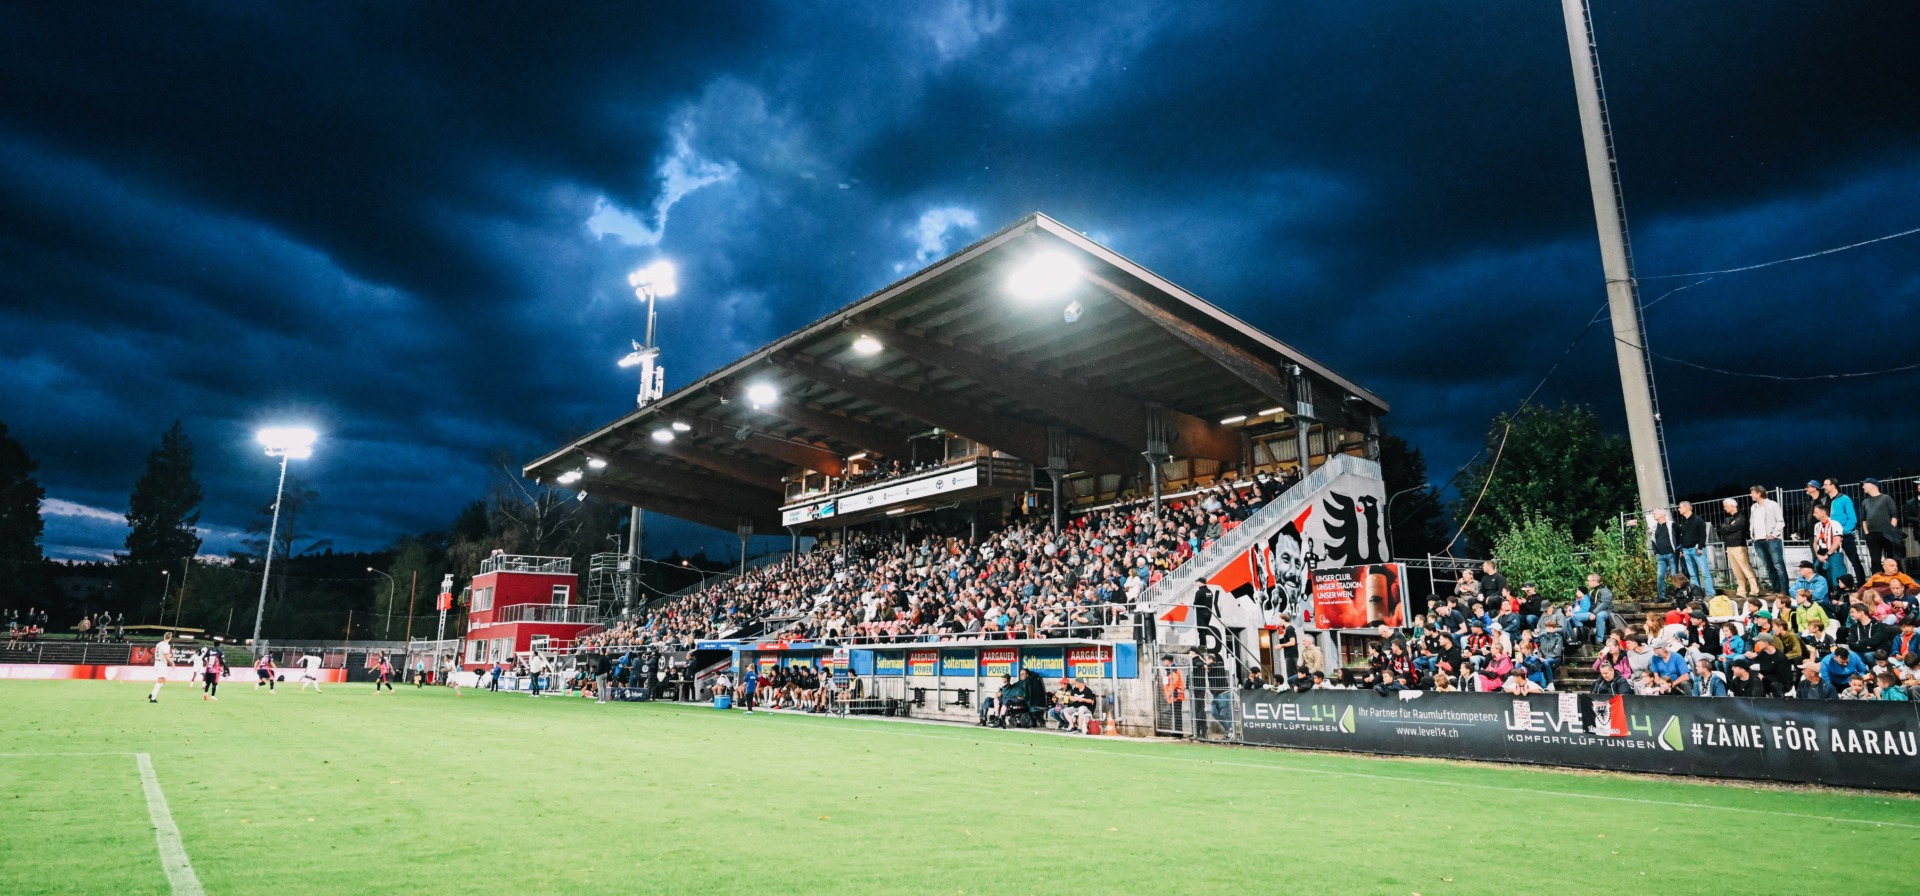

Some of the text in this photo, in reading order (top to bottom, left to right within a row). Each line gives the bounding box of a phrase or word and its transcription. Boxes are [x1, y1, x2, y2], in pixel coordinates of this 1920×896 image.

[1316, 573, 1352, 582] UNSER CLUB.
[1336, 581, 1363, 589] STADION.
[1337, 590, 1354, 598] WEIN.
[910, 652, 937, 661] AARGAUER
[983, 651, 1015, 660] AARGAUER
[915, 665, 932, 673] POWER
[988, 665, 1010, 674] POWER
[1358, 707, 1499, 722] Ihr Partner für Raumluftkompetenz
[1243, 722, 1338, 732] KOMFORTLÜFTUNGEN
[1396, 726, 1459, 738] www.level14.ch
[1507, 734, 1656, 749] KOMFORTLÜFTUNGEN
[1691, 718, 1917, 756] #ZÄME FÖR AARAU
